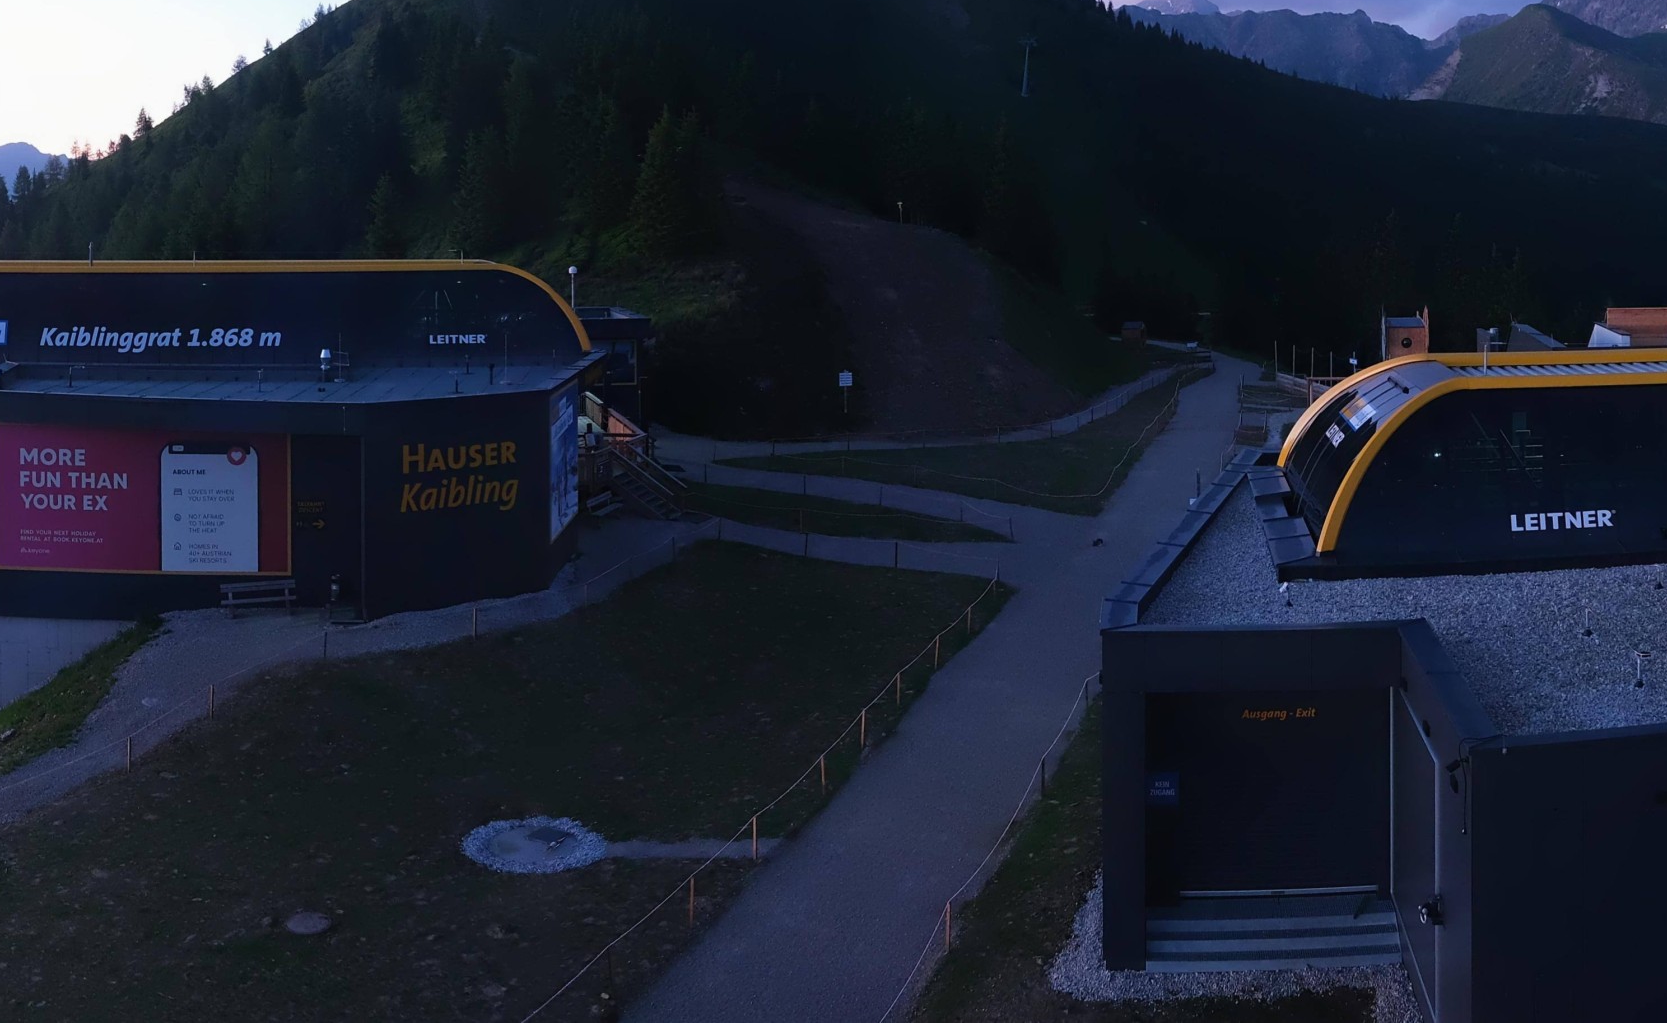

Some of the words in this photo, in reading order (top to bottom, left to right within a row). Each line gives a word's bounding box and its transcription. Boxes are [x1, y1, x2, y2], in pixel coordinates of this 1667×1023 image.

[39, 326, 182, 353] Kaiblinggrat
[186, 327, 255, 347] 1.868
[258, 330, 282, 347] m
[429, 333, 487, 345] LEITNER
[19, 447, 86, 466] MORE
[402, 440, 517, 474] HAUSER
[19, 470, 61, 488] FUN
[67, 472, 128, 489] THAN
[20, 493, 77, 511] YOUR
[83, 494, 109, 511] EX
[400, 474, 520, 514] Kaibling
[1510, 509, 1615, 532] LEITNER
[1241, 708, 1288, 721] Ausgang
[1295, 707, 1317, 719] Exit
[1149, 788, 1176, 796] ZUGANG
[1155, 780, 1170, 788] KEIN
